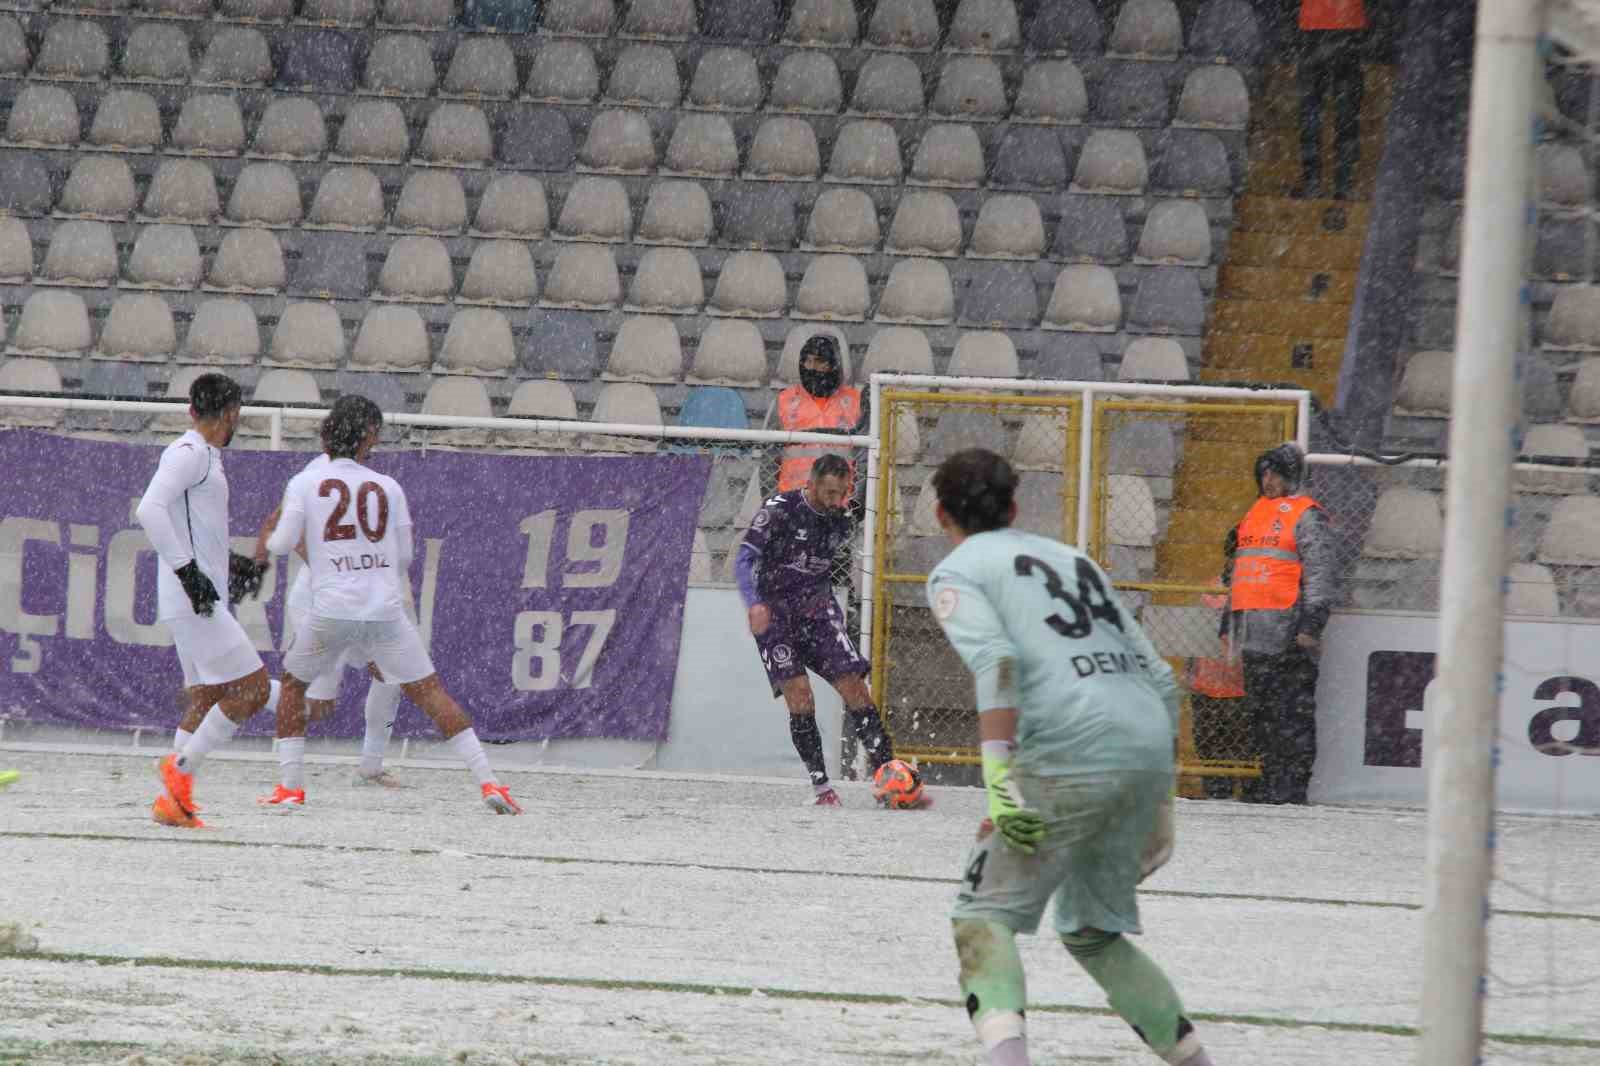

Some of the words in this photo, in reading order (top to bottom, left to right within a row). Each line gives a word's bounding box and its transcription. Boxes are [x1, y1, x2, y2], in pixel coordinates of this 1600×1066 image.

[319, 478, 389, 543] 20
[519, 509, 631, 589] 19
[1014, 554, 1125, 639] 34
[511, 608, 617, 691] 87
